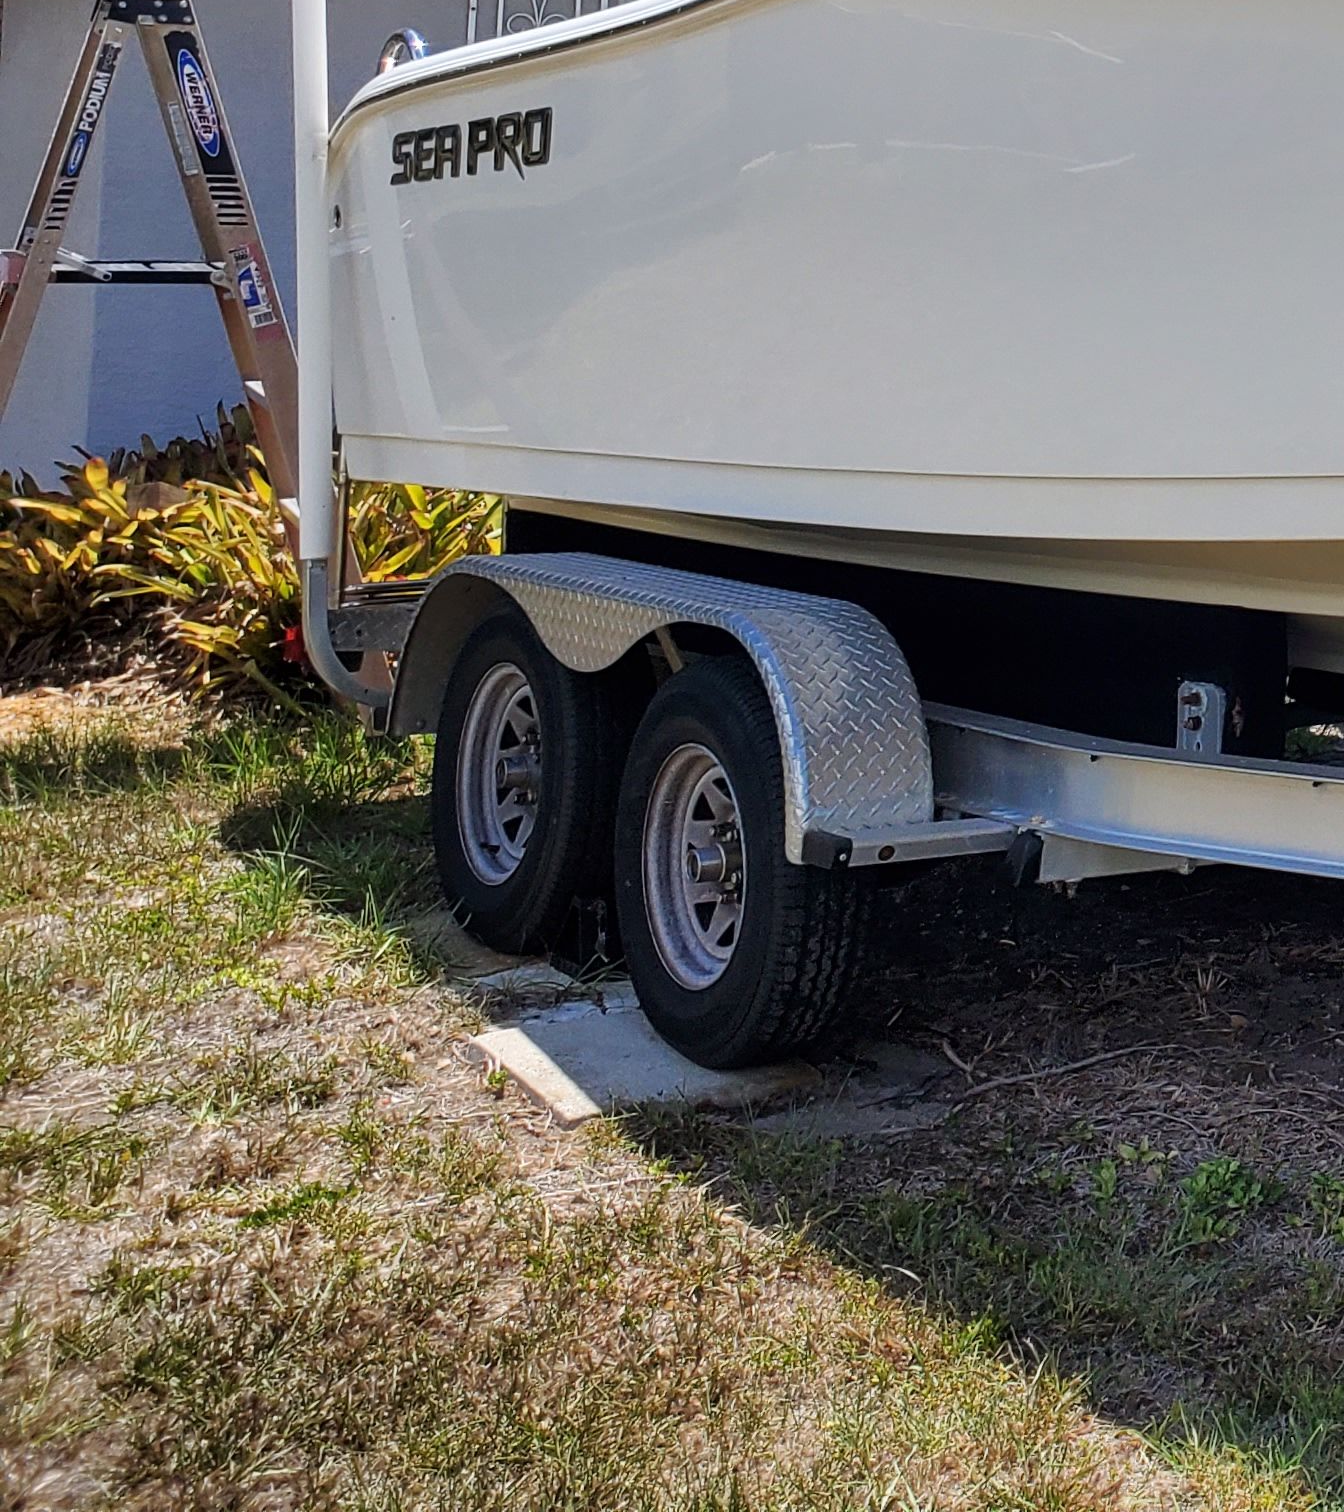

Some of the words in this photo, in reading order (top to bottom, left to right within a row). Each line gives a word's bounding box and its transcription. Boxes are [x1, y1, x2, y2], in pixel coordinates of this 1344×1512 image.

[79, 71, 112, 132] PODIUM
[185, 71, 213, 136] WERNER
[390, 123, 462, 185] SEA
[466, 106, 553, 182] PRO
